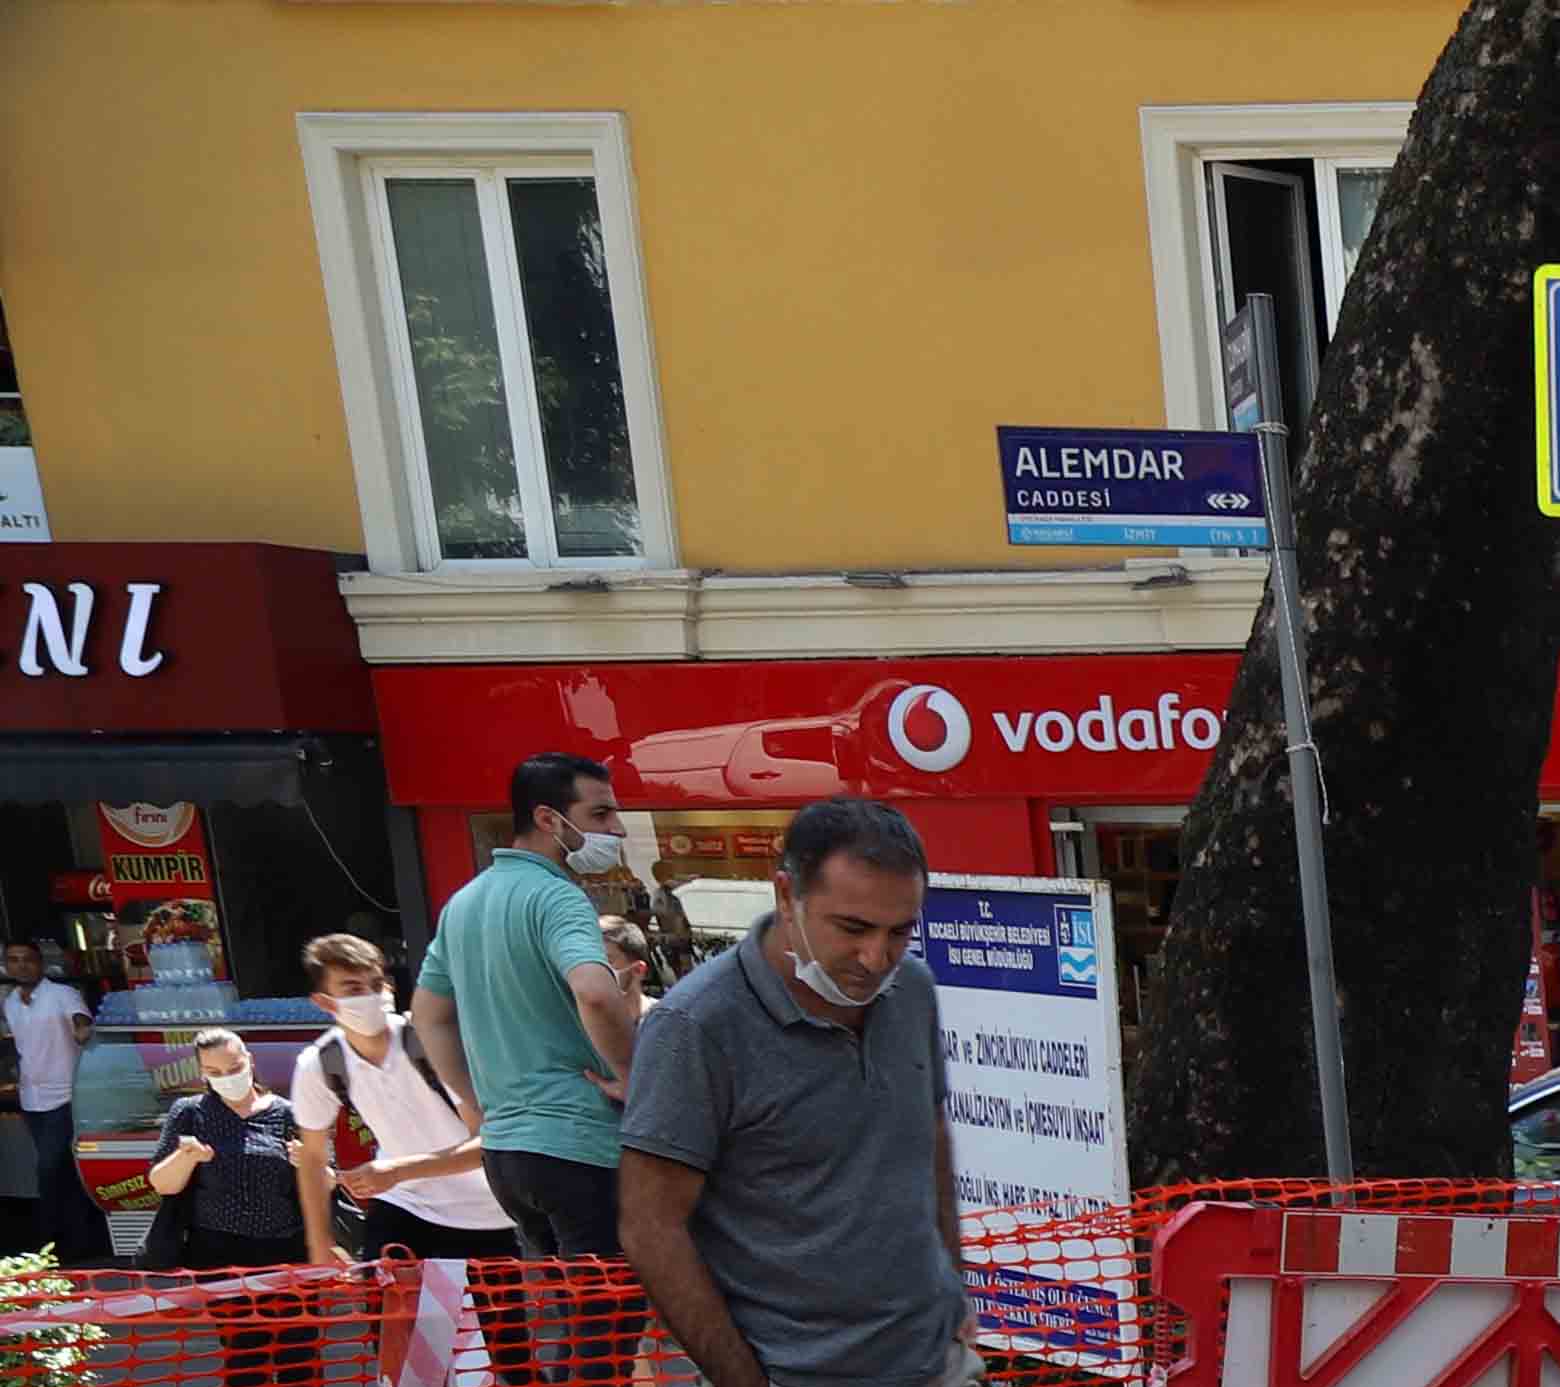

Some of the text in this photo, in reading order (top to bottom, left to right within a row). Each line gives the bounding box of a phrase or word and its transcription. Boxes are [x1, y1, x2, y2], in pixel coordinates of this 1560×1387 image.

[1015, 447, 1185, 481] ALEMDAR
[1016, 487, 1111, 509] CADDESİ
[991, 692, 1228, 753] vodafo
[111, 851, 209, 882] KUMPİR
[976, 1024, 1039, 1073] ZİNCİRLİKUYU
[1040, 1036, 1090, 1080] CADDELERİ
[1024, 1092, 1072, 1144] İÇMESUYU
[1072, 1098, 1105, 1148] İNŞAAT
